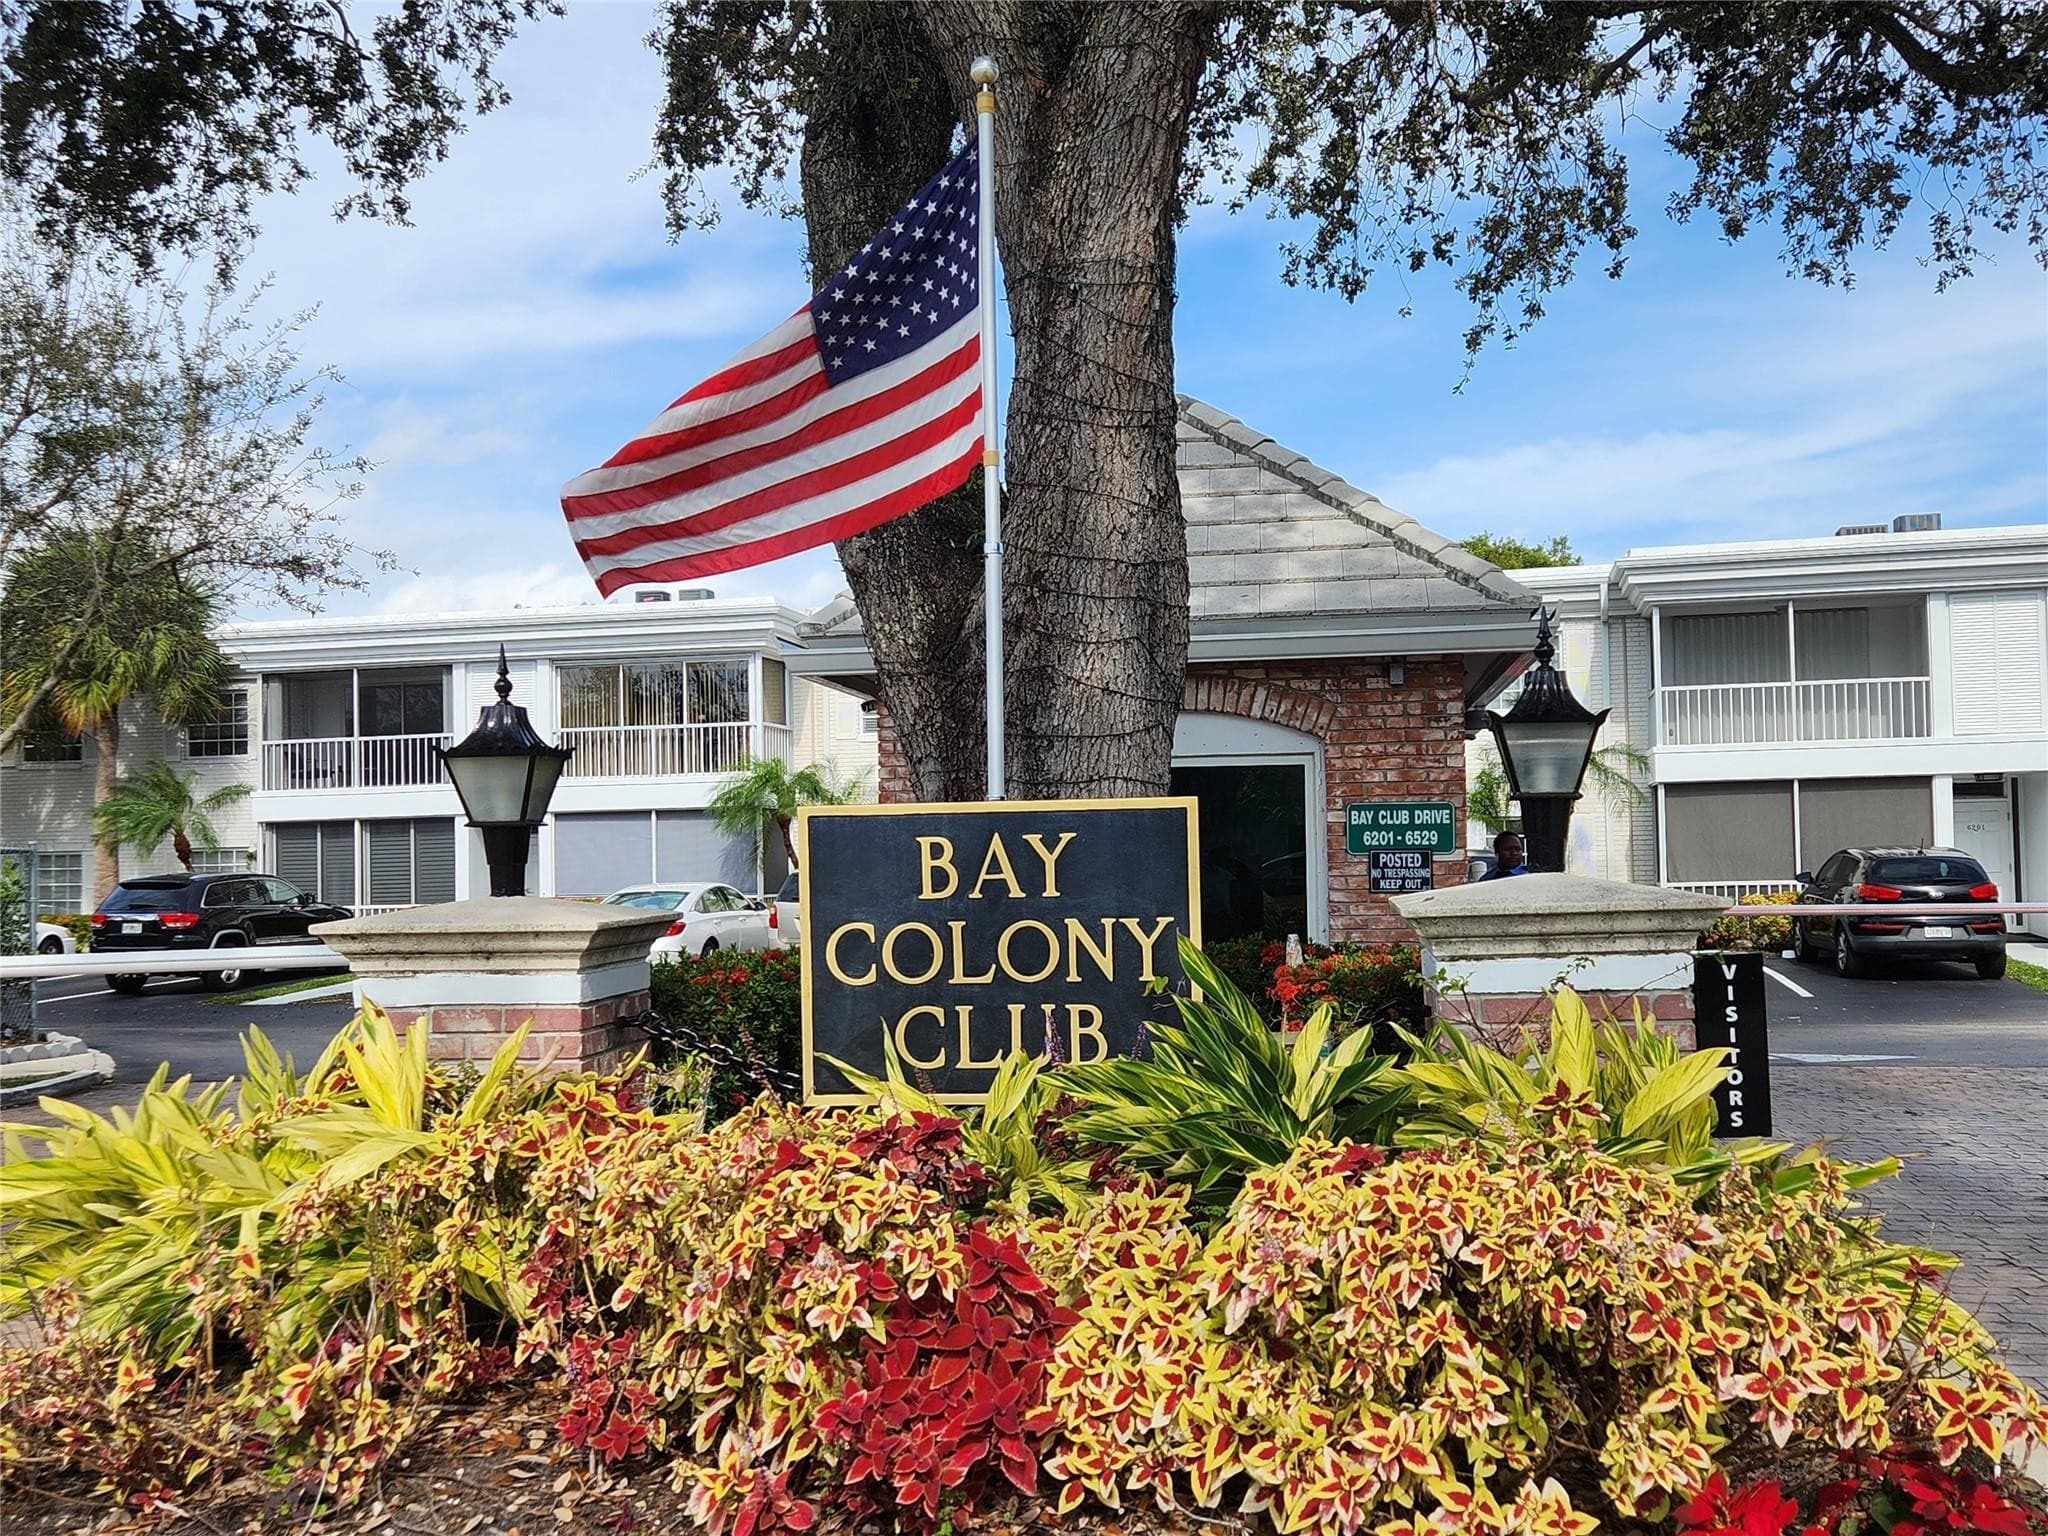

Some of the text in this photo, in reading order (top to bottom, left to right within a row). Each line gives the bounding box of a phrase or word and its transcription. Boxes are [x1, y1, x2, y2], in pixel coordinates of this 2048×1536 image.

[1351, 809, 1451, 825] BAY CLUB DRIVE
[1967, 824, 1985, 832] 6201
[916, 831, 1077, 900] BAY
[1379, 853, 1422, 868] POSTED
[1371, 868, 1431, 879] NO TRESPASSING
[1379, 879, 1422, 889] KEEP OUT
[825, 916, 1174, 986] COLONY
[895, 1003, 1109, 1070] CLUB
[1721, 964, 1744, 1128] VISITORS
